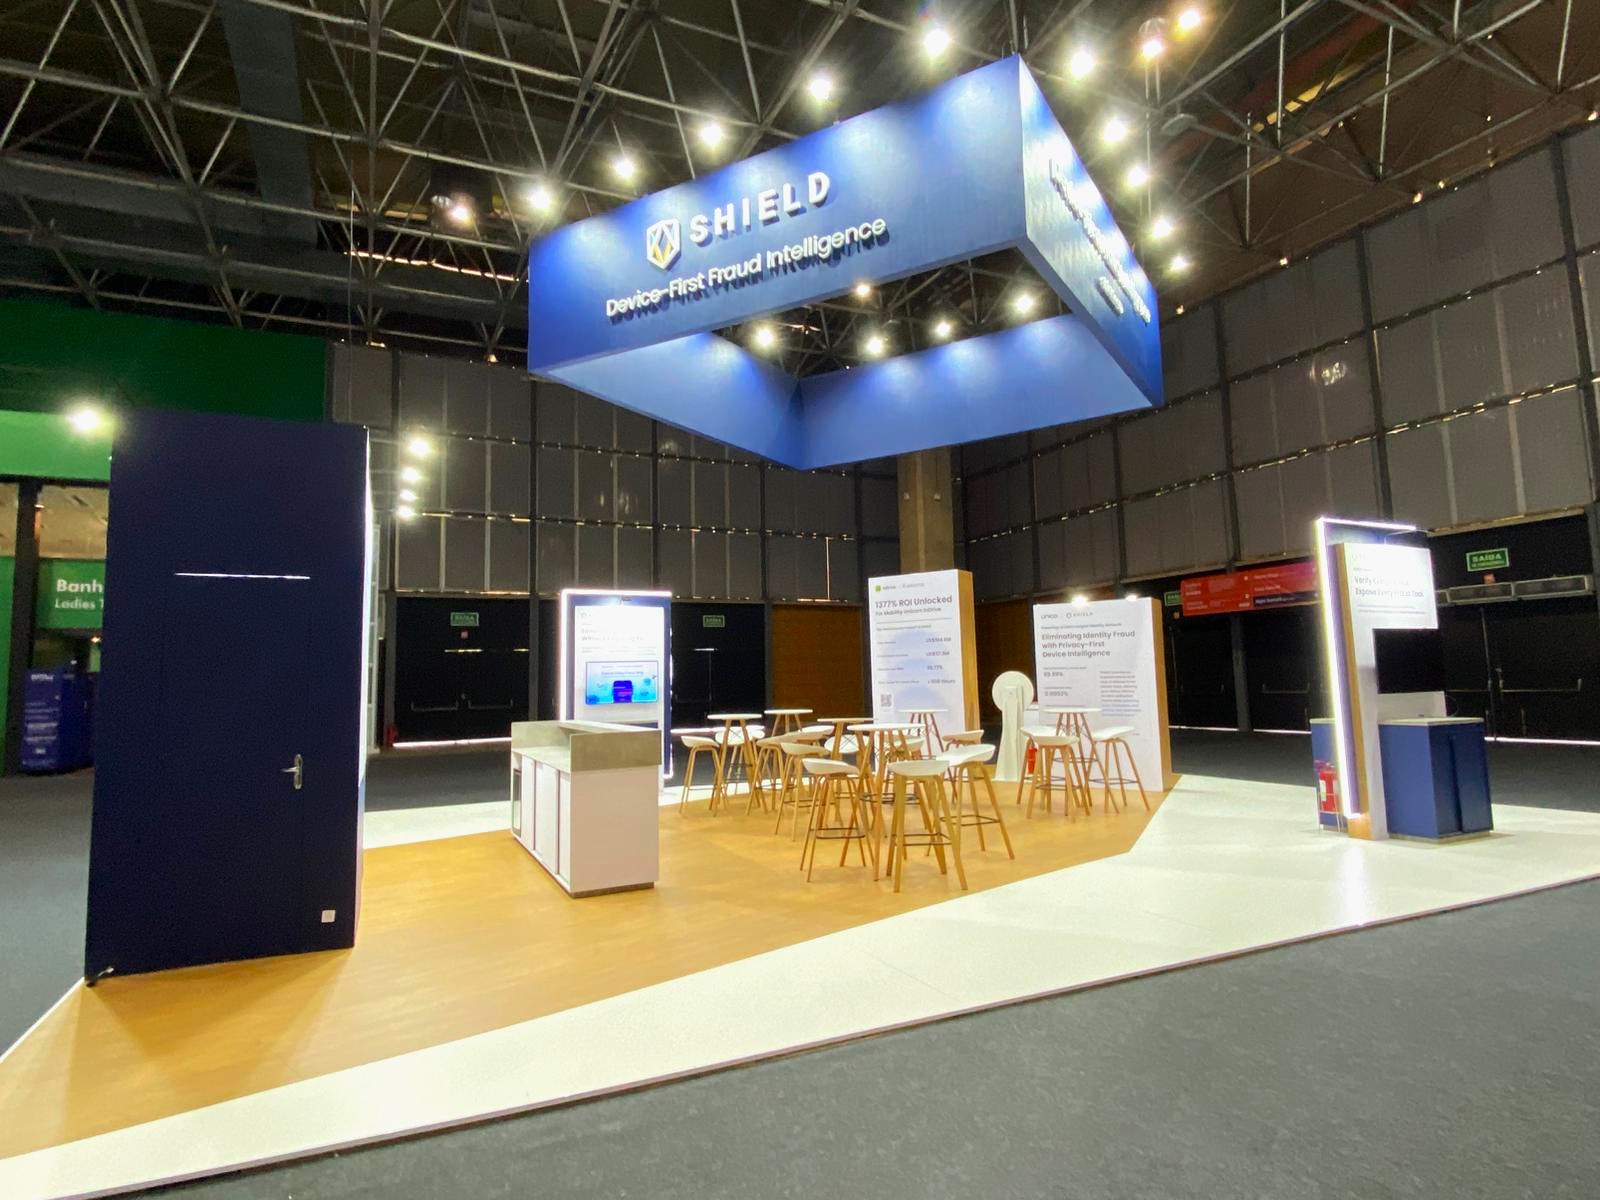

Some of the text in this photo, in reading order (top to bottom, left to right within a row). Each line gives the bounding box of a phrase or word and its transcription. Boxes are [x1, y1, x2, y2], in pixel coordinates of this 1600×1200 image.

[689, 171, 831, 245] SHIELD
[606, 217, 888, 318] Device-First Fraud Intelligence
[56, 578, 103, 593] Banh
[54, 597, 96, 609] Ladies
[899, 599, 912, 607] ROI
[914, 595, 952, 606] Unlocked
[1041, 630, 1136, 641] Eliminating Identity Fraud
[1058, 640, 1105, 650] Privacy-First
[1067, 650, 1111, 658] Intelligence
